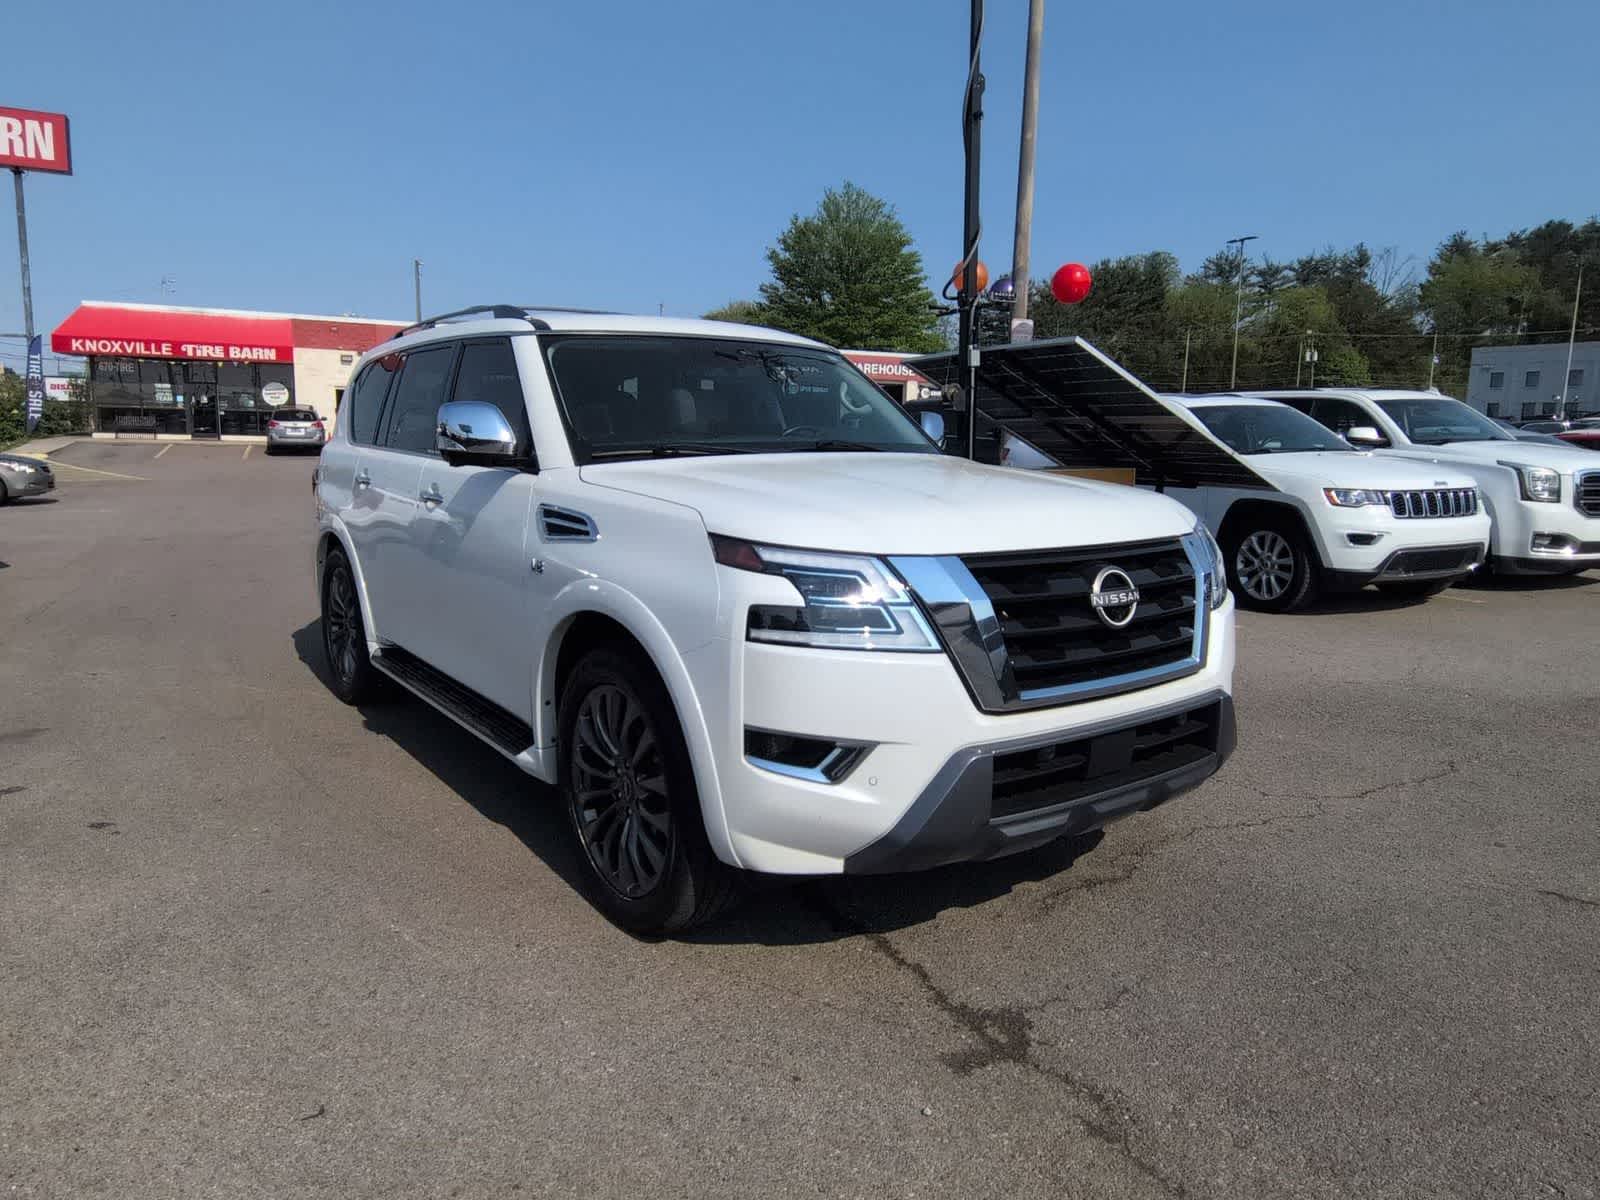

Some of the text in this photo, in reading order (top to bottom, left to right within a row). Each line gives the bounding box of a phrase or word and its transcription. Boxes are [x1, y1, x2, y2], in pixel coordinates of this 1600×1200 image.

[0, 116, 54, 160] RN
[72, 339, 173, 355] KNOXVILLE
[229, 346, 277, 360] BARN
[854, 363, 916, 376] AREHOUSE
[28, 353, 43, 420] TIRE SALE
[1093, 591, 1140, 605] NISSAN
